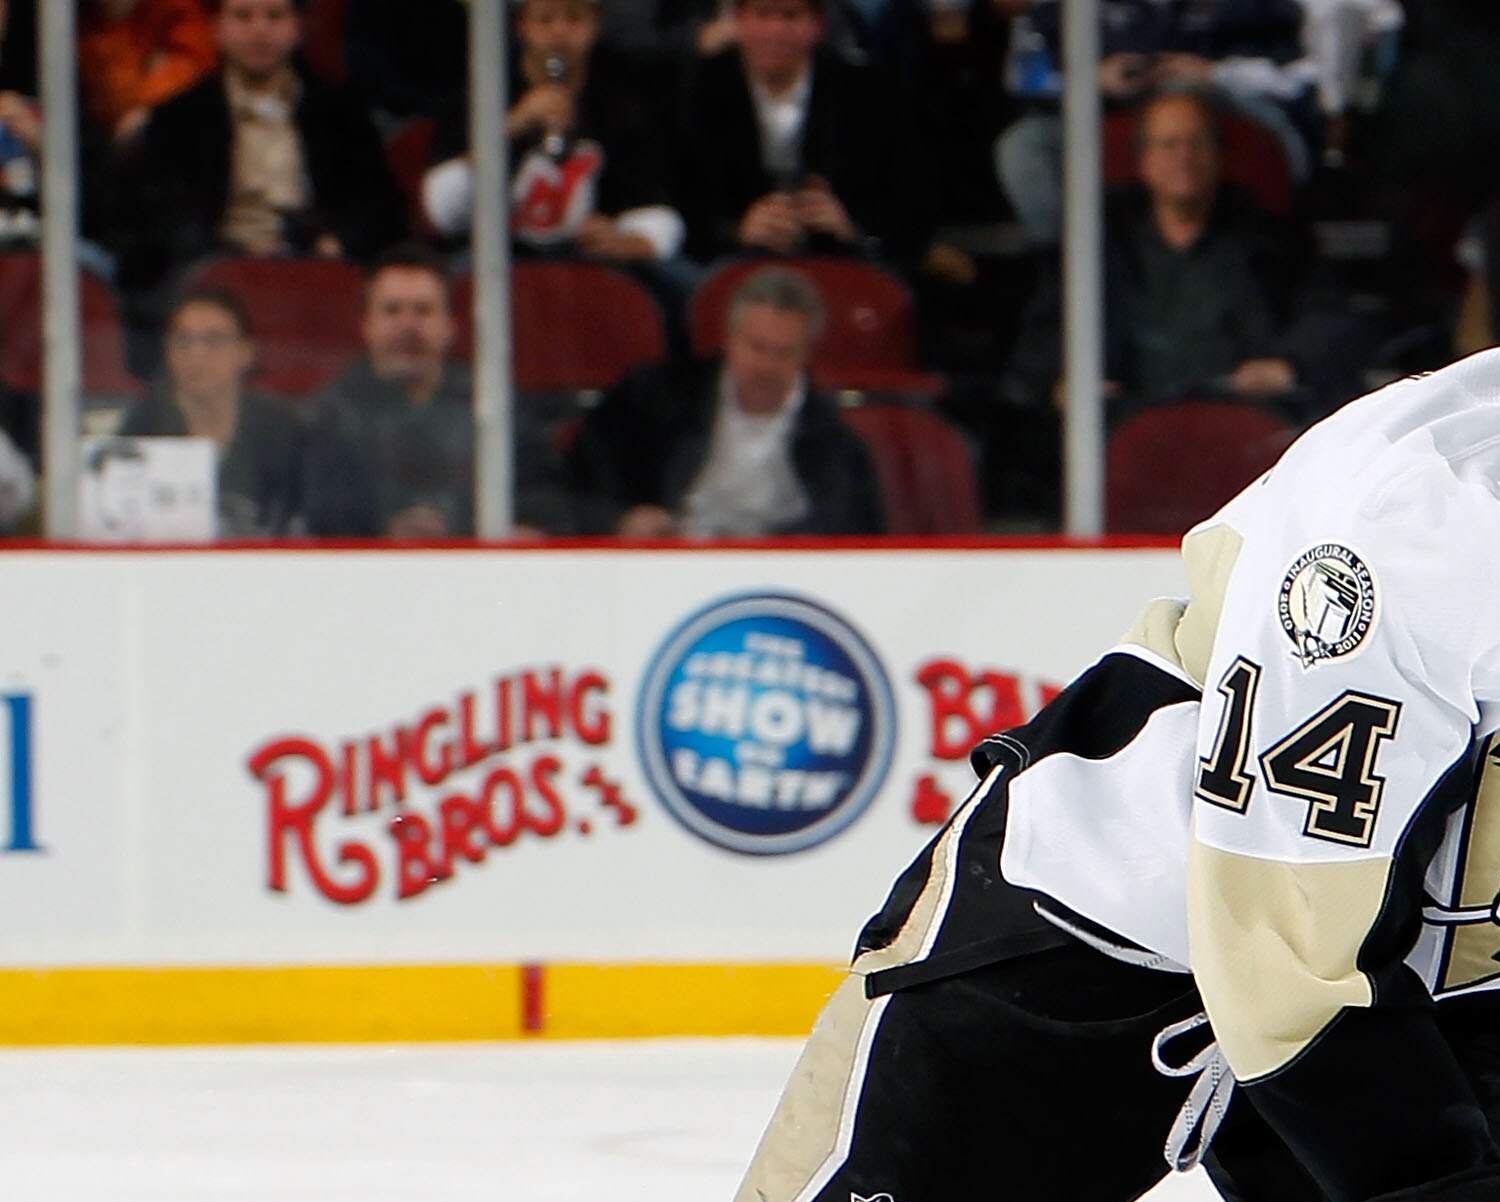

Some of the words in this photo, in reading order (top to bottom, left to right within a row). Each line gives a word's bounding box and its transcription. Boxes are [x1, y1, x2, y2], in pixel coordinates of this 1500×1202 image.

[1287, 545, 1354, 580] INAUGURAL
[1353, 561, 1375, 623] SEASON
[1335, 633, 1362, 655] 2011
[667, 680, 862, 758] SHOW
[1195, 654, 1403, 849] 14
[248, 666, 612, 906] RINGLING
[388, 755, 595, 901] BROS.
